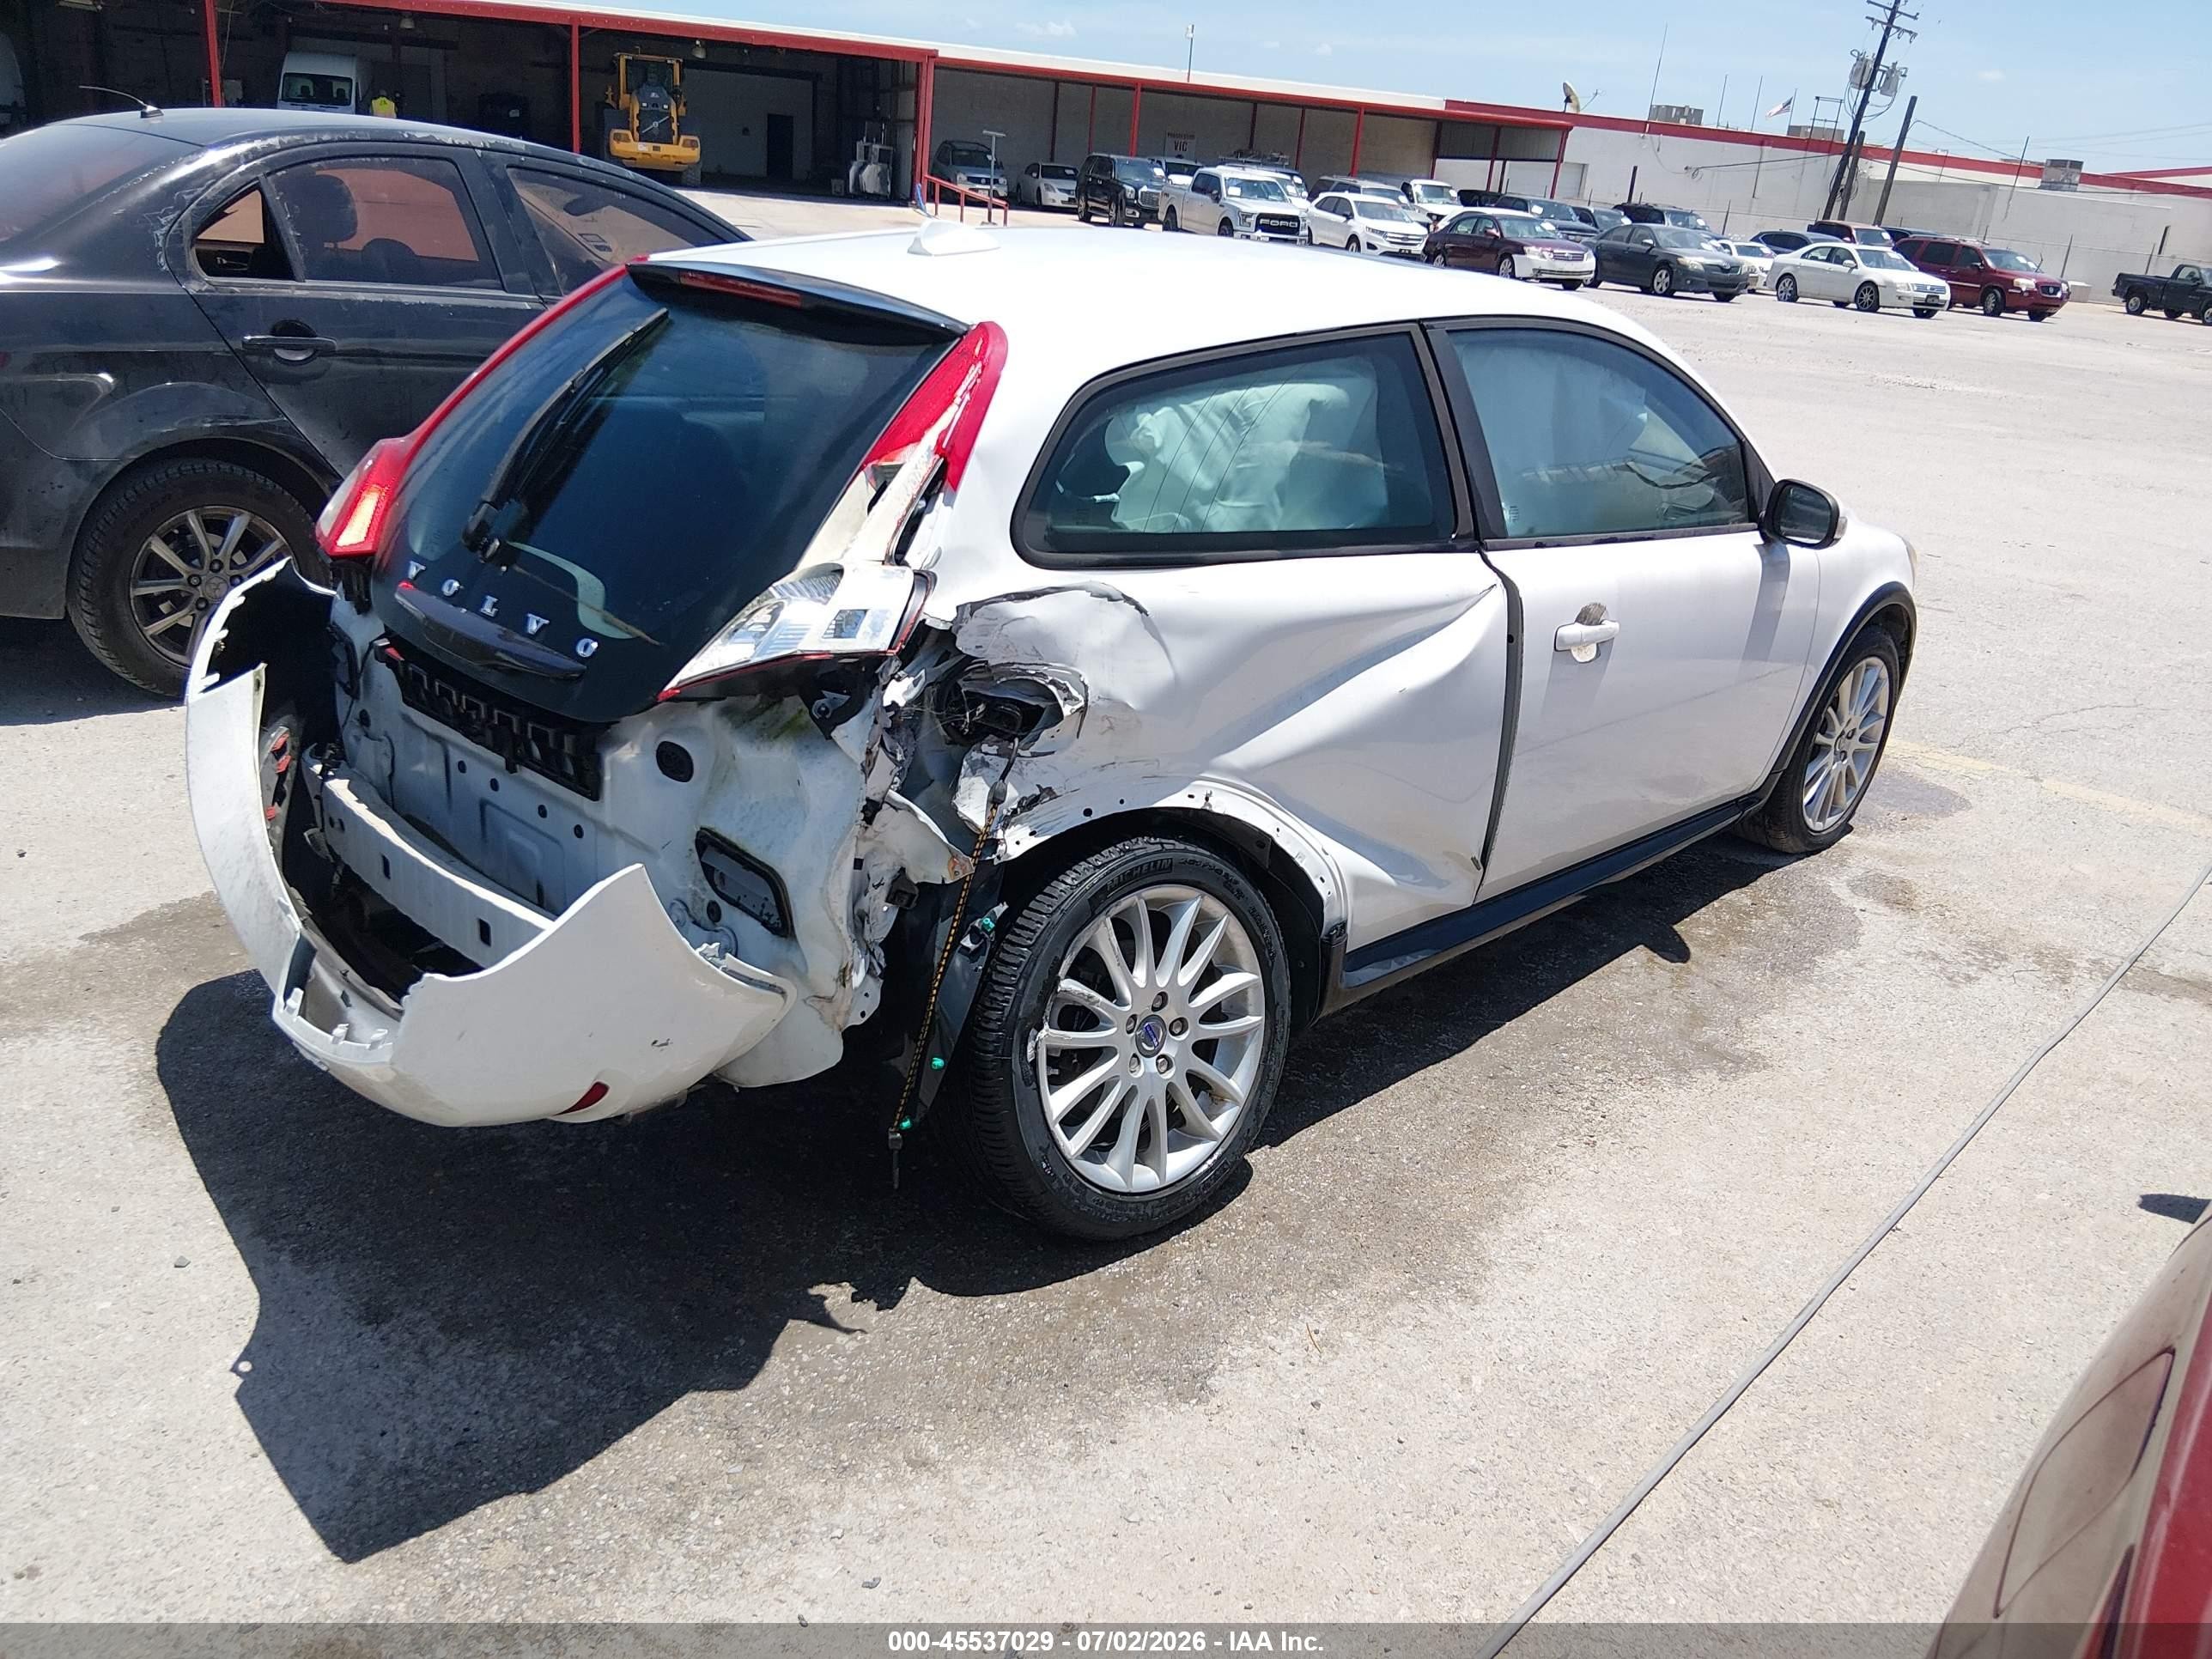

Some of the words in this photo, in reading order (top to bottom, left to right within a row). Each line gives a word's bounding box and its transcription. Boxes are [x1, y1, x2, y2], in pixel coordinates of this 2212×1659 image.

[1259, 218, 1298, 228] FORD
[408, 561, 599, 658] VOLVO
[1107, 858, 1173, 890] MICHELIN
